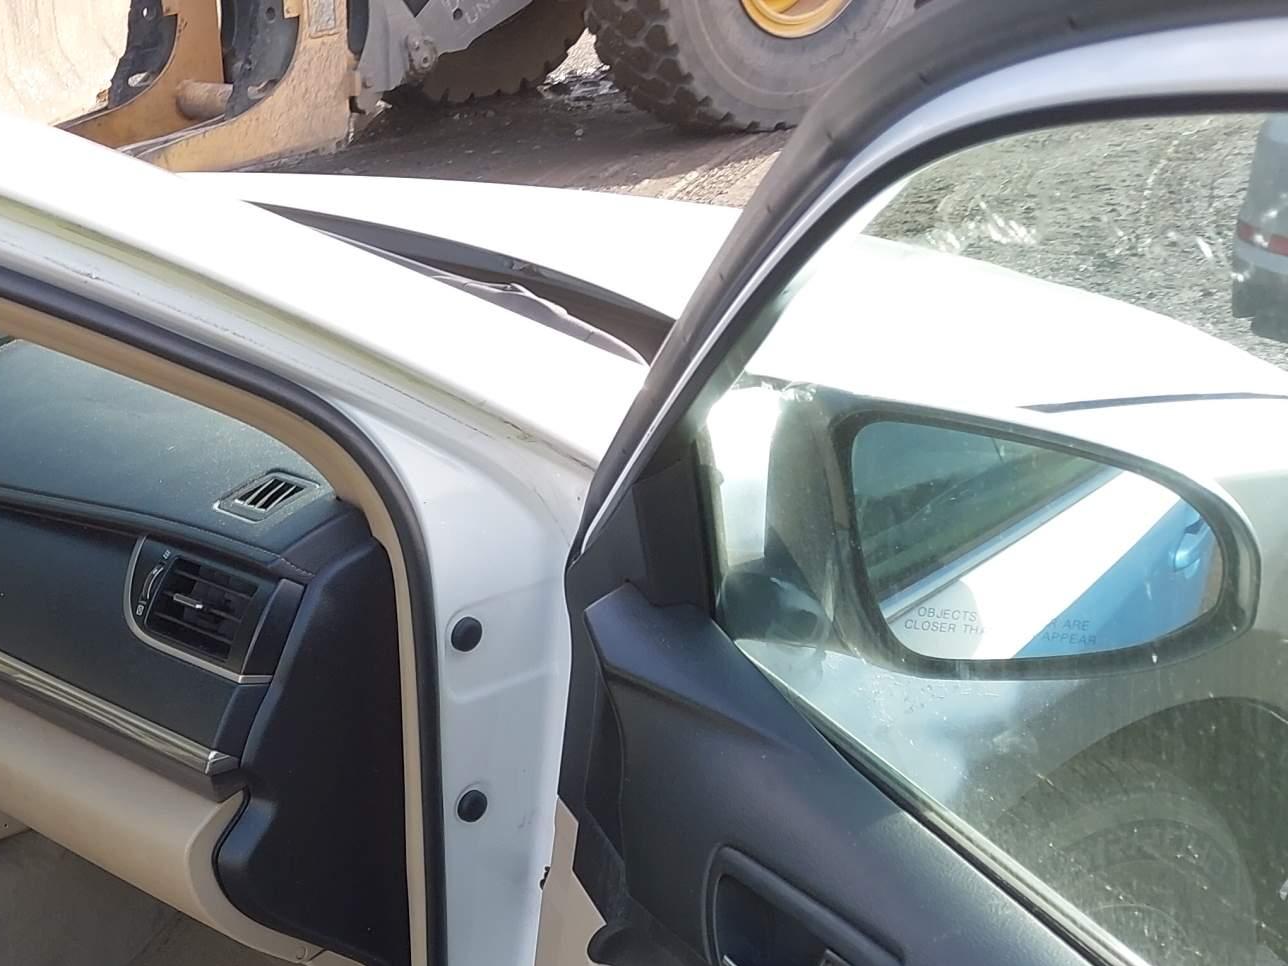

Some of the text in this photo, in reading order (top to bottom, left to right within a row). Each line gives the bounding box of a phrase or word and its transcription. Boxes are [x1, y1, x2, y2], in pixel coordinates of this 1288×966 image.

[917, 606, 978, 622] OBJECTS
[1063, 619, 1090, 631] ARE
[904, 619, 957, 633] CLOSER
[1041, 631, 1097, 646] APPEAR
